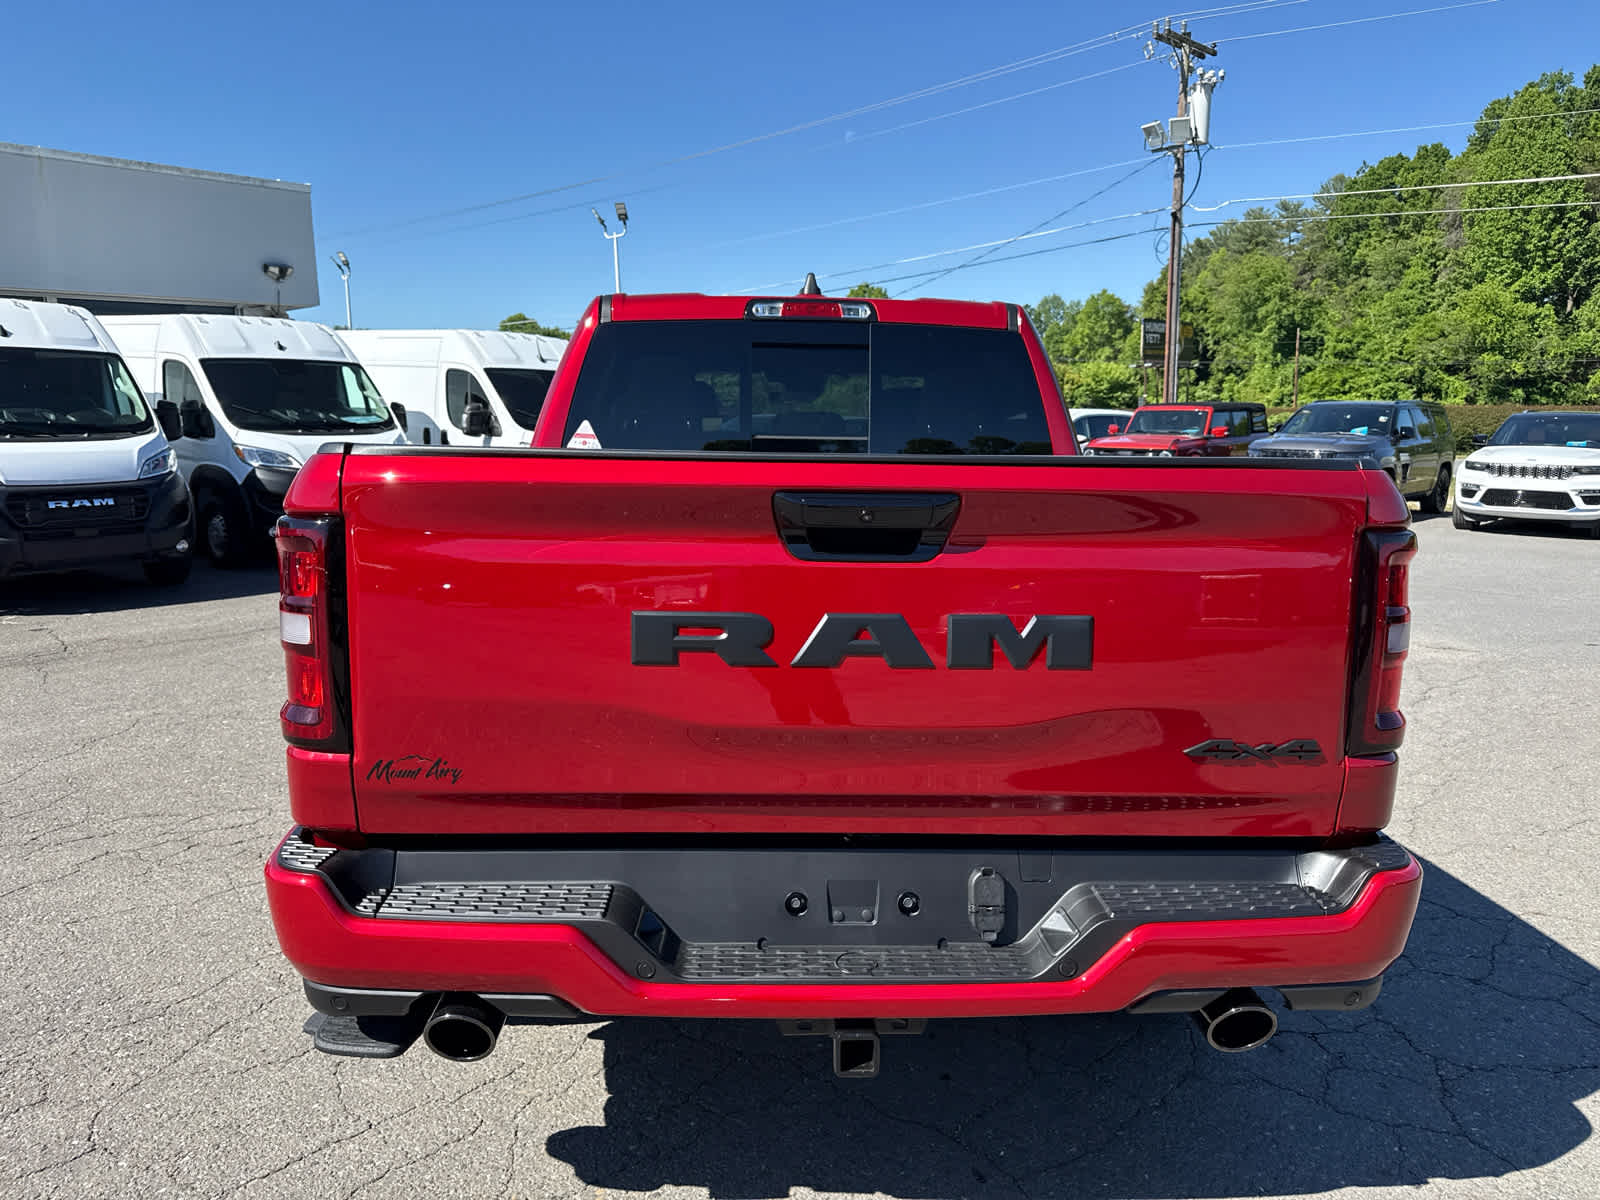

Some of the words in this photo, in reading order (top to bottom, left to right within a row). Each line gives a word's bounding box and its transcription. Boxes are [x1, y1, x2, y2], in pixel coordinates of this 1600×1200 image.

[47, 498, 115, 509] RAM
[631, 610, 1095, 670] RAM
[366, 759, 422, 784] Mount
[425, 757, 463, 784] Airy
